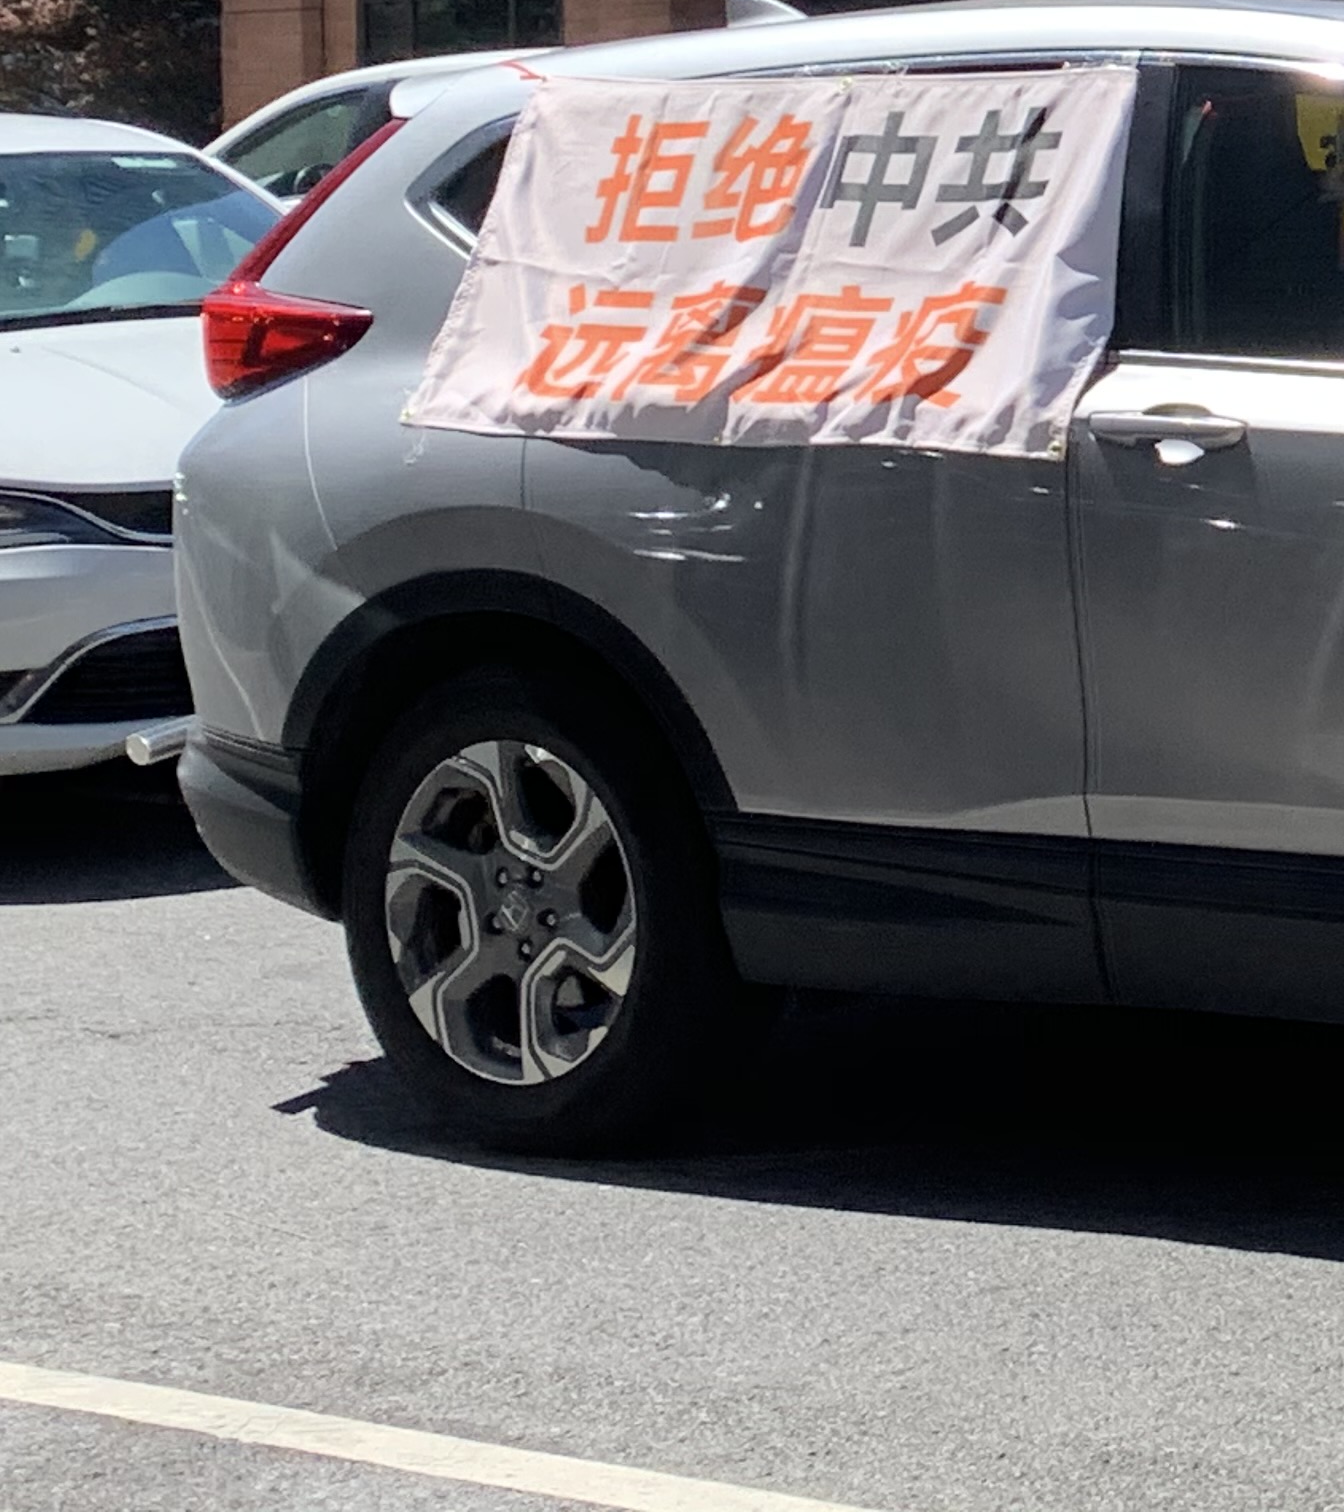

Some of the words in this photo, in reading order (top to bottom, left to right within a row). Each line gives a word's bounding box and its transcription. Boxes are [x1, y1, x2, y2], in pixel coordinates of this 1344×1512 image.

[584, 106, 1063, 248] 拒绝中共
[514, 281, 1008, 409] 远离瘟疫
